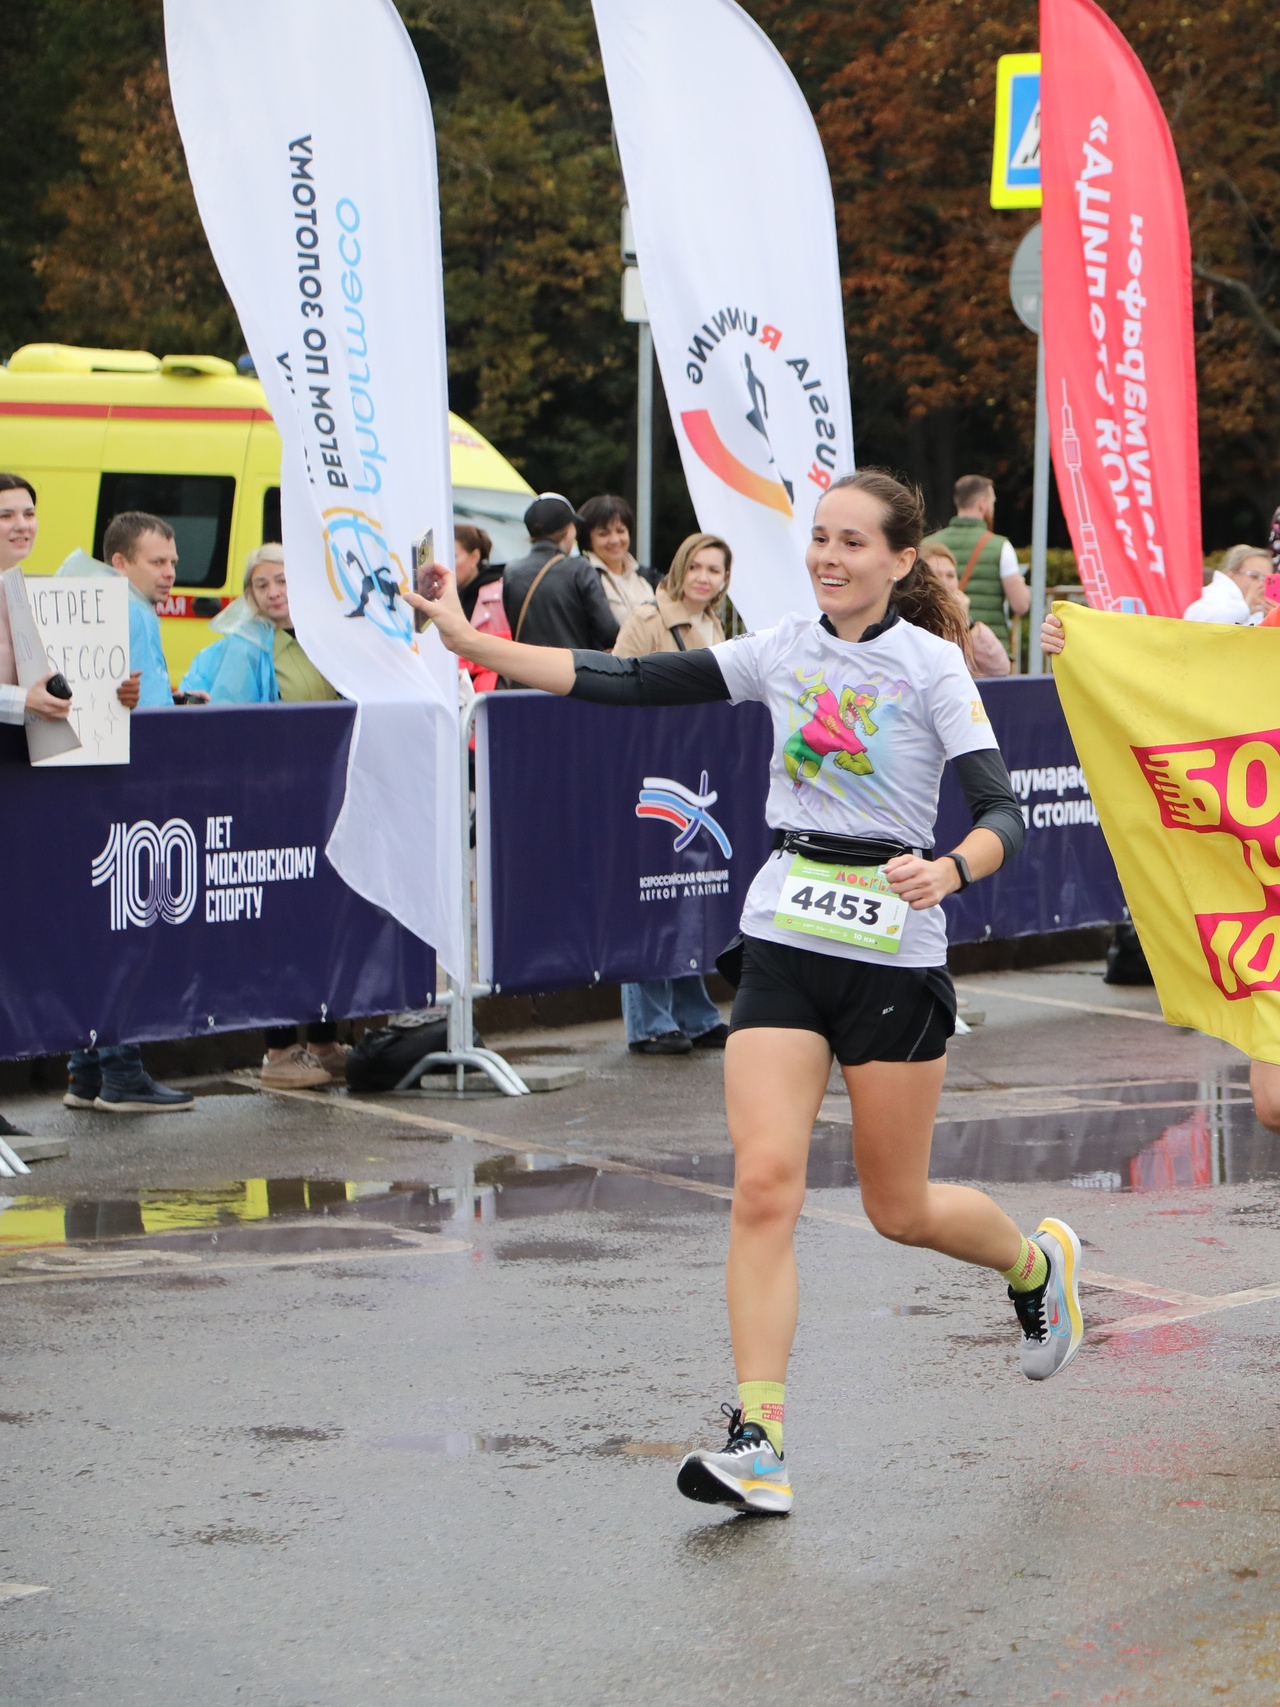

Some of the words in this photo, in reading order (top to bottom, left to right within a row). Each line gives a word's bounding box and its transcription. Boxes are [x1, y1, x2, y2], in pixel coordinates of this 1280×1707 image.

[205, 815, 233, 849] ЛЕТ
[91, 817, 198, 931] 100
[205, 846, 317, 886] МОСКОВСКОМУ
[205, 886, 263, 923] СПОРТУ
[791, 885, 881, 925] 4453
[853, 932, 862, 941] 10
